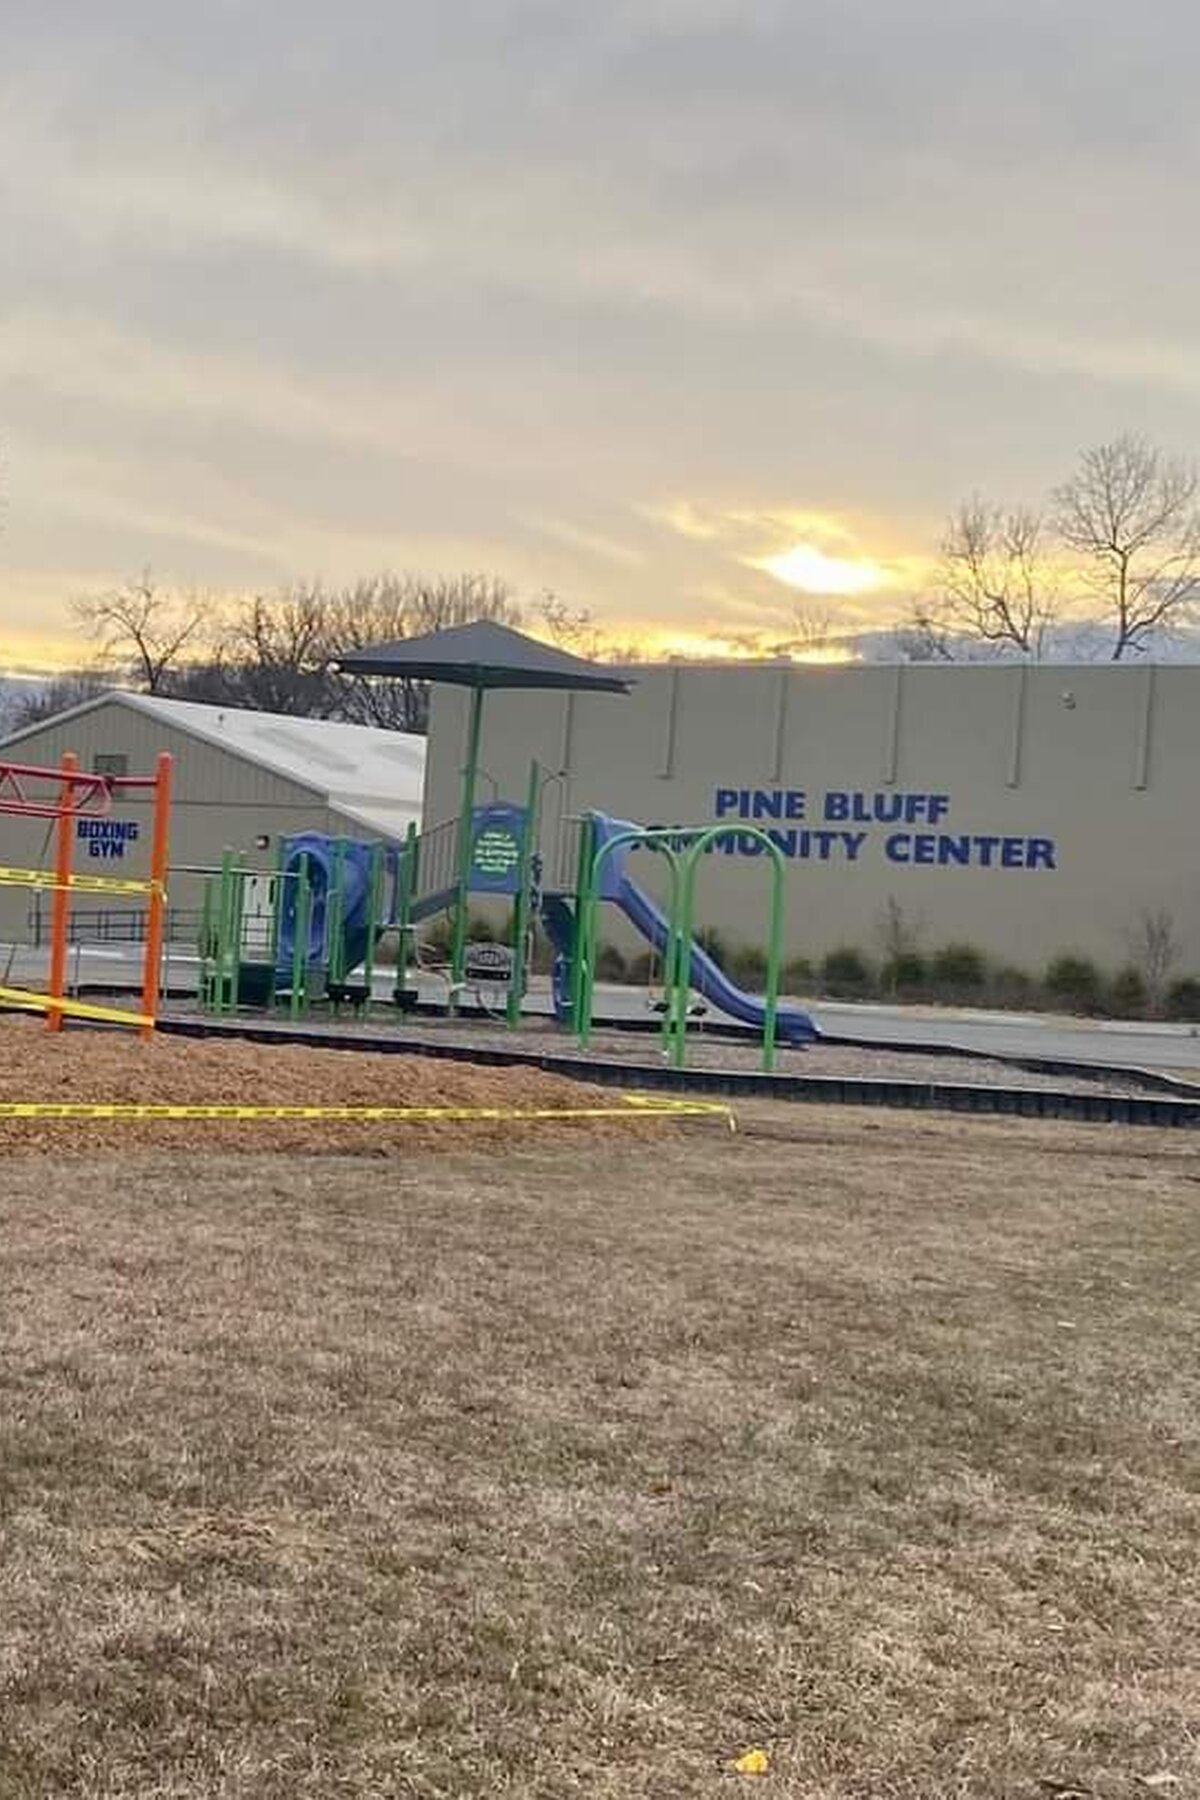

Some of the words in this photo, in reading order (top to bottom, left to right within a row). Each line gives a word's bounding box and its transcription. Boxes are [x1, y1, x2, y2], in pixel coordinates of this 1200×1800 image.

[715, 789, 805, 819] PINE
[824, 792, 949, 824] BLUFF
[77, 820, 138, 840] BOXING
[89, 840, 124, 857] GYM
[885, 833, 1056, 870] CENTER
